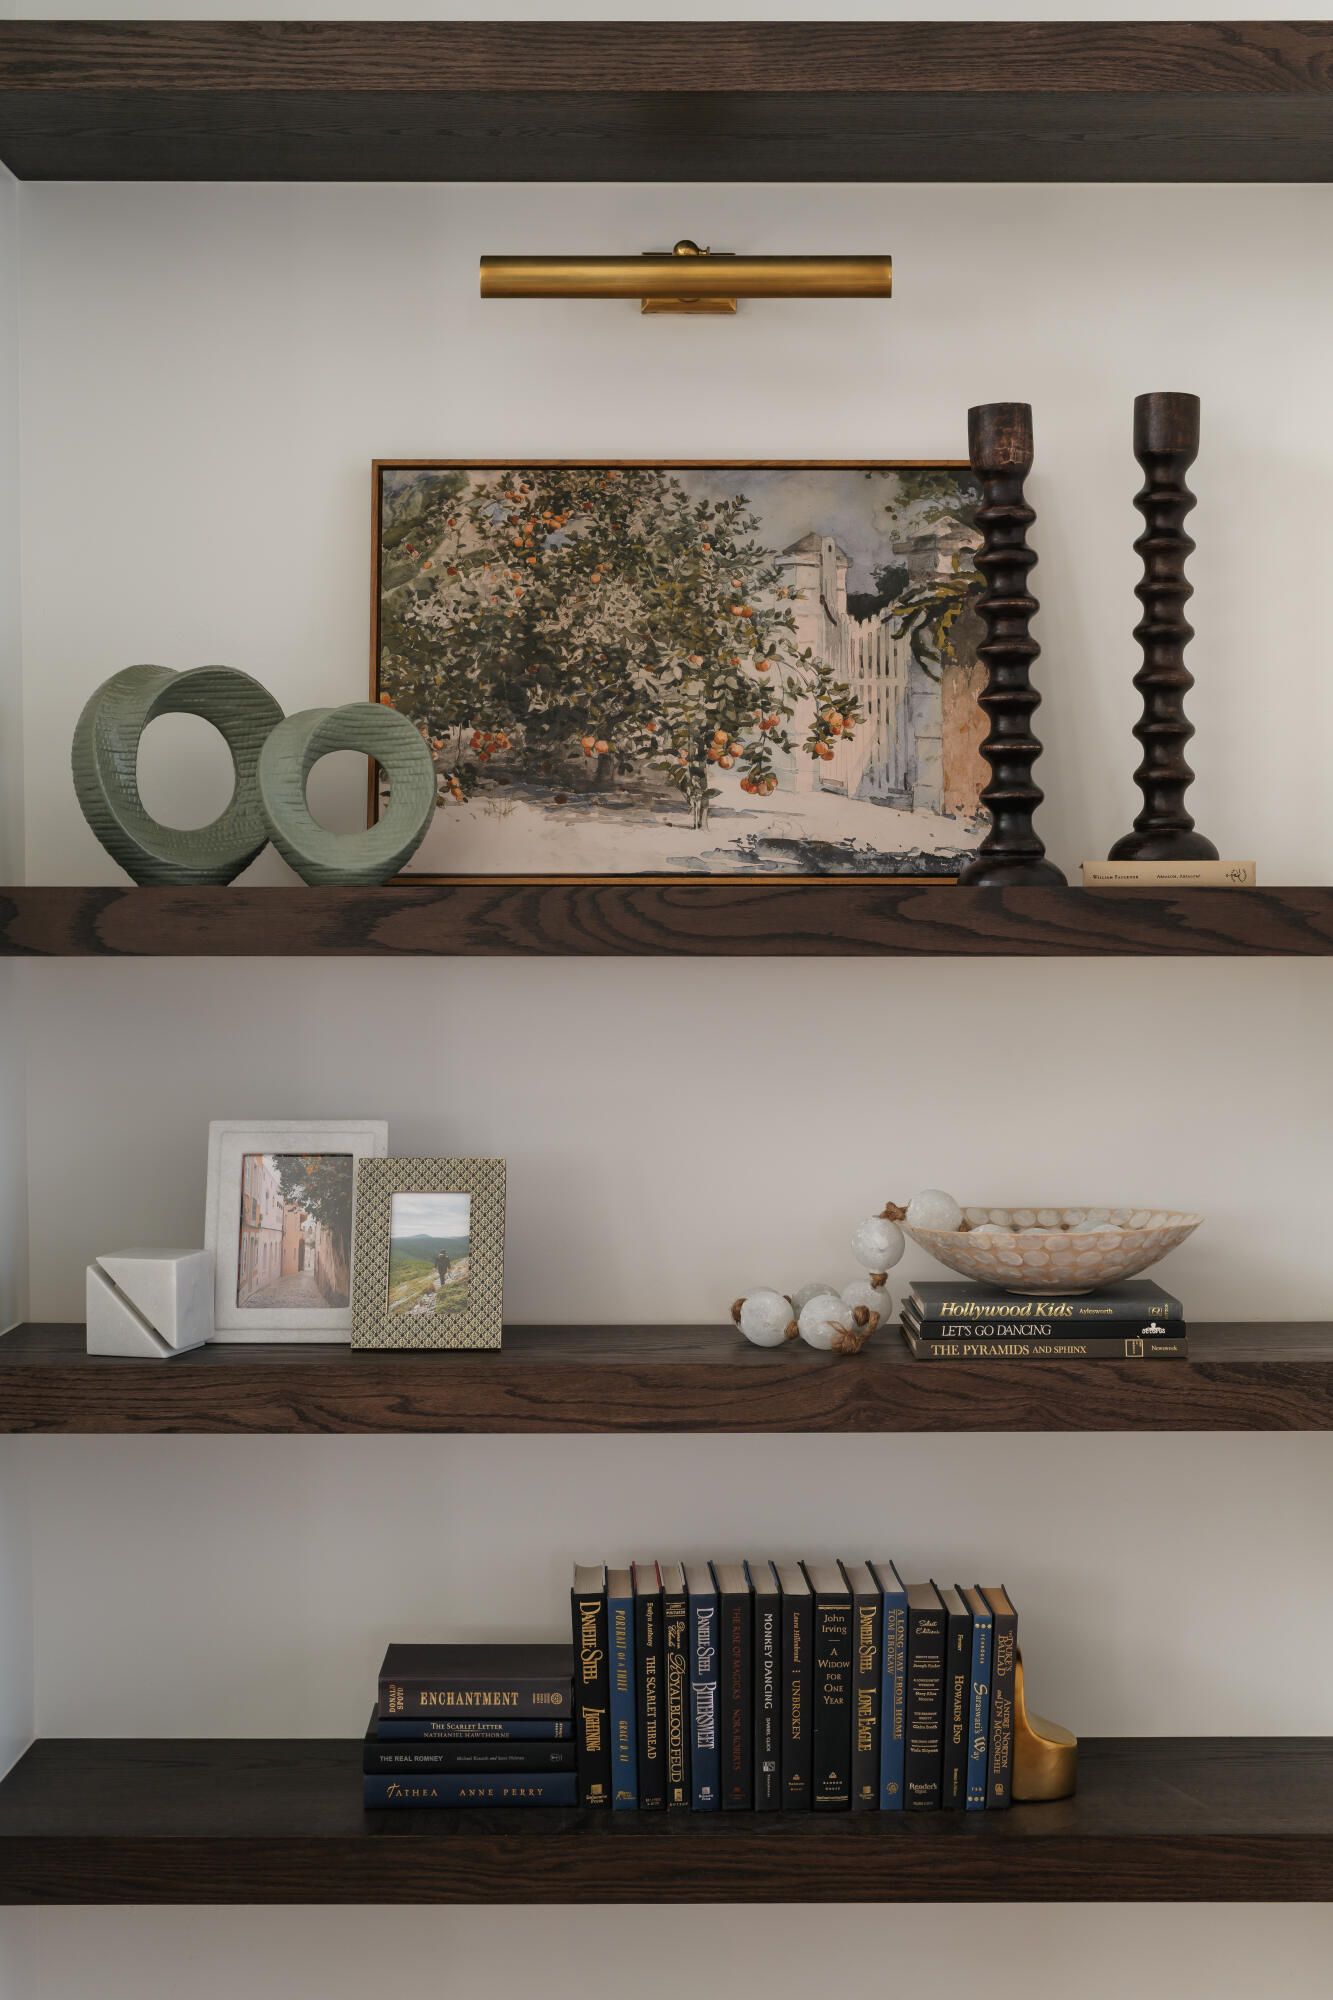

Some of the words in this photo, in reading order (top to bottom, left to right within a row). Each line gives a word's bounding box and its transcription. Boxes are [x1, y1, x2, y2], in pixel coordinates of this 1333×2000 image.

[939, 1302, 1033, 1321] Hollywood
[1034, 1302, 1074, 1317] Kids
[1079, 1307, 1113, 1316] Aylesworth
[941, 1325, 972, 1337] LET'S
[974, 1325, 995, 1337] GO
[997, 1324, 1052, 1337] DANCING
[931, 1344, 958, 1356] THE
[963, 1344, 1030, 1356] PYRAMIDS
[1032, 1345, 1052, 1354] AND
[1054, 1345, 1087, 1354] SPHINX
[579, 1600, 602, 1648] DANIELLE
[696, 1607, 714, 1646] DANIELLE
[732, 1607, 742, 1624] THE
[824, 1614, 845, 1623] John
[859, 1606, 877, 1645] DANIELLE
[887, 1609, 895, 1631] TOM
[896, 1608, 905, 1616] A
[615, 1609, 628, 1649] PORTRAIT
[764, 1613, 773, 1657] MONKEY
[822, 1625, 847, 1635] Irving
[896, 1618, 905, 1648] LONG
[580, 1647, 604, 1684] STEEL
[646, 1656, 656, 1674] THE
[697, 1646, 715, 1675] STEEL
[732, 1645, 742, 1658] OF
[818, 1659, 850, 1668] WIDOW
[830, 1648, 838, 1656] A
[858, 1645, 877, 1674] STEEL
[887, 1633, 895, 1674] BROKAW
[896, 1651, 904, 1672] WAY
[997, 1634, 1007, 1676] BALLAD
[1004, 1634, 1014, 1672] DUKE'S
[669, 1651, 686, 1704] ROYAL
[764, 1660, 773, 1709] DANCING
[824, 1683, 844, 1693] ONE
[826, 1673, 841, 1681] FOR
[895, 1675, 904, 1704] FROM
[419, 1691, 519, 1706] ENCHANTMENT
[646, 1676, 656, 1717] SCARLET
[791, 1679, 801, 1740] UNBROKEN
[823, 1695, 844, 1705] YEAR
[858, 1687, 877, 1716] LONE
[953, 1674, 965, 1721] HOWARDS
[973, 1681, 988, 1735] Saraswati's
[994, 1699, 1004, 1717] LYN
[430, 1722, 445, 1730] THE
[446, 1722, 476, 1731] SCARLET
[477, 1723, 503, 1731] LETTER
[670, 1704, 682, 1746] BLOOD
[692, 1681, 717, 1749] BITTERSWEET
[894, 1708, 903, 1740] HOME
[1002, 1698, 1012, 1729] ANDRE
[582, 1706, 606, 1752] LIGHTNING
[647, 1720, 657, 1759] THREAD
[858, 1716, 877, 1752] EAGLE
[953, 1723, 963, 1745] END
[970, 1736, 986, 1761] Way
[1001, 1731, 1011, 1768] NORTON
[670, 1748, 682, 1783] FEUD
[386, 1783, 438, 1799] TATHEA
[459, 1788, 494, 1797] ANNE
[503, 1787, 543, 1796] PERRY
